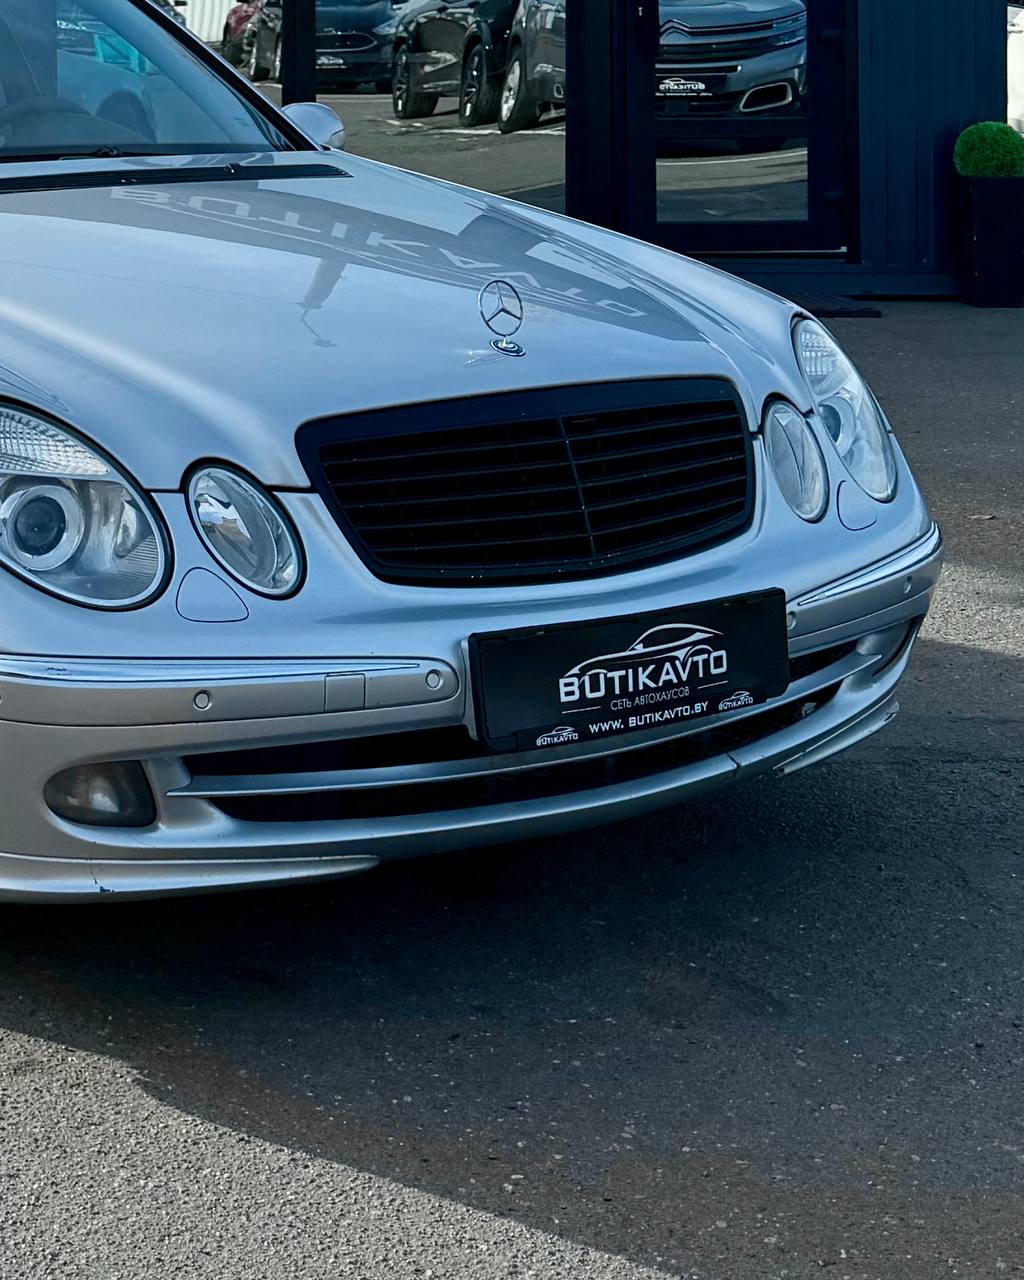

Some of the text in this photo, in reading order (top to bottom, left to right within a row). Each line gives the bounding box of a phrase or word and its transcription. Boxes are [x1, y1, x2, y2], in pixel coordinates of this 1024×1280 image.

[558, 649, 727, 702] BUTIKAVTO
[610, 686, 690, 711] СЕТЬ АВТОХАУСОВ
[589, 701, 709, 734] WWW. BUTIKAVTO.BY
[536, 732, 578, 746] BUTIKAVTO
